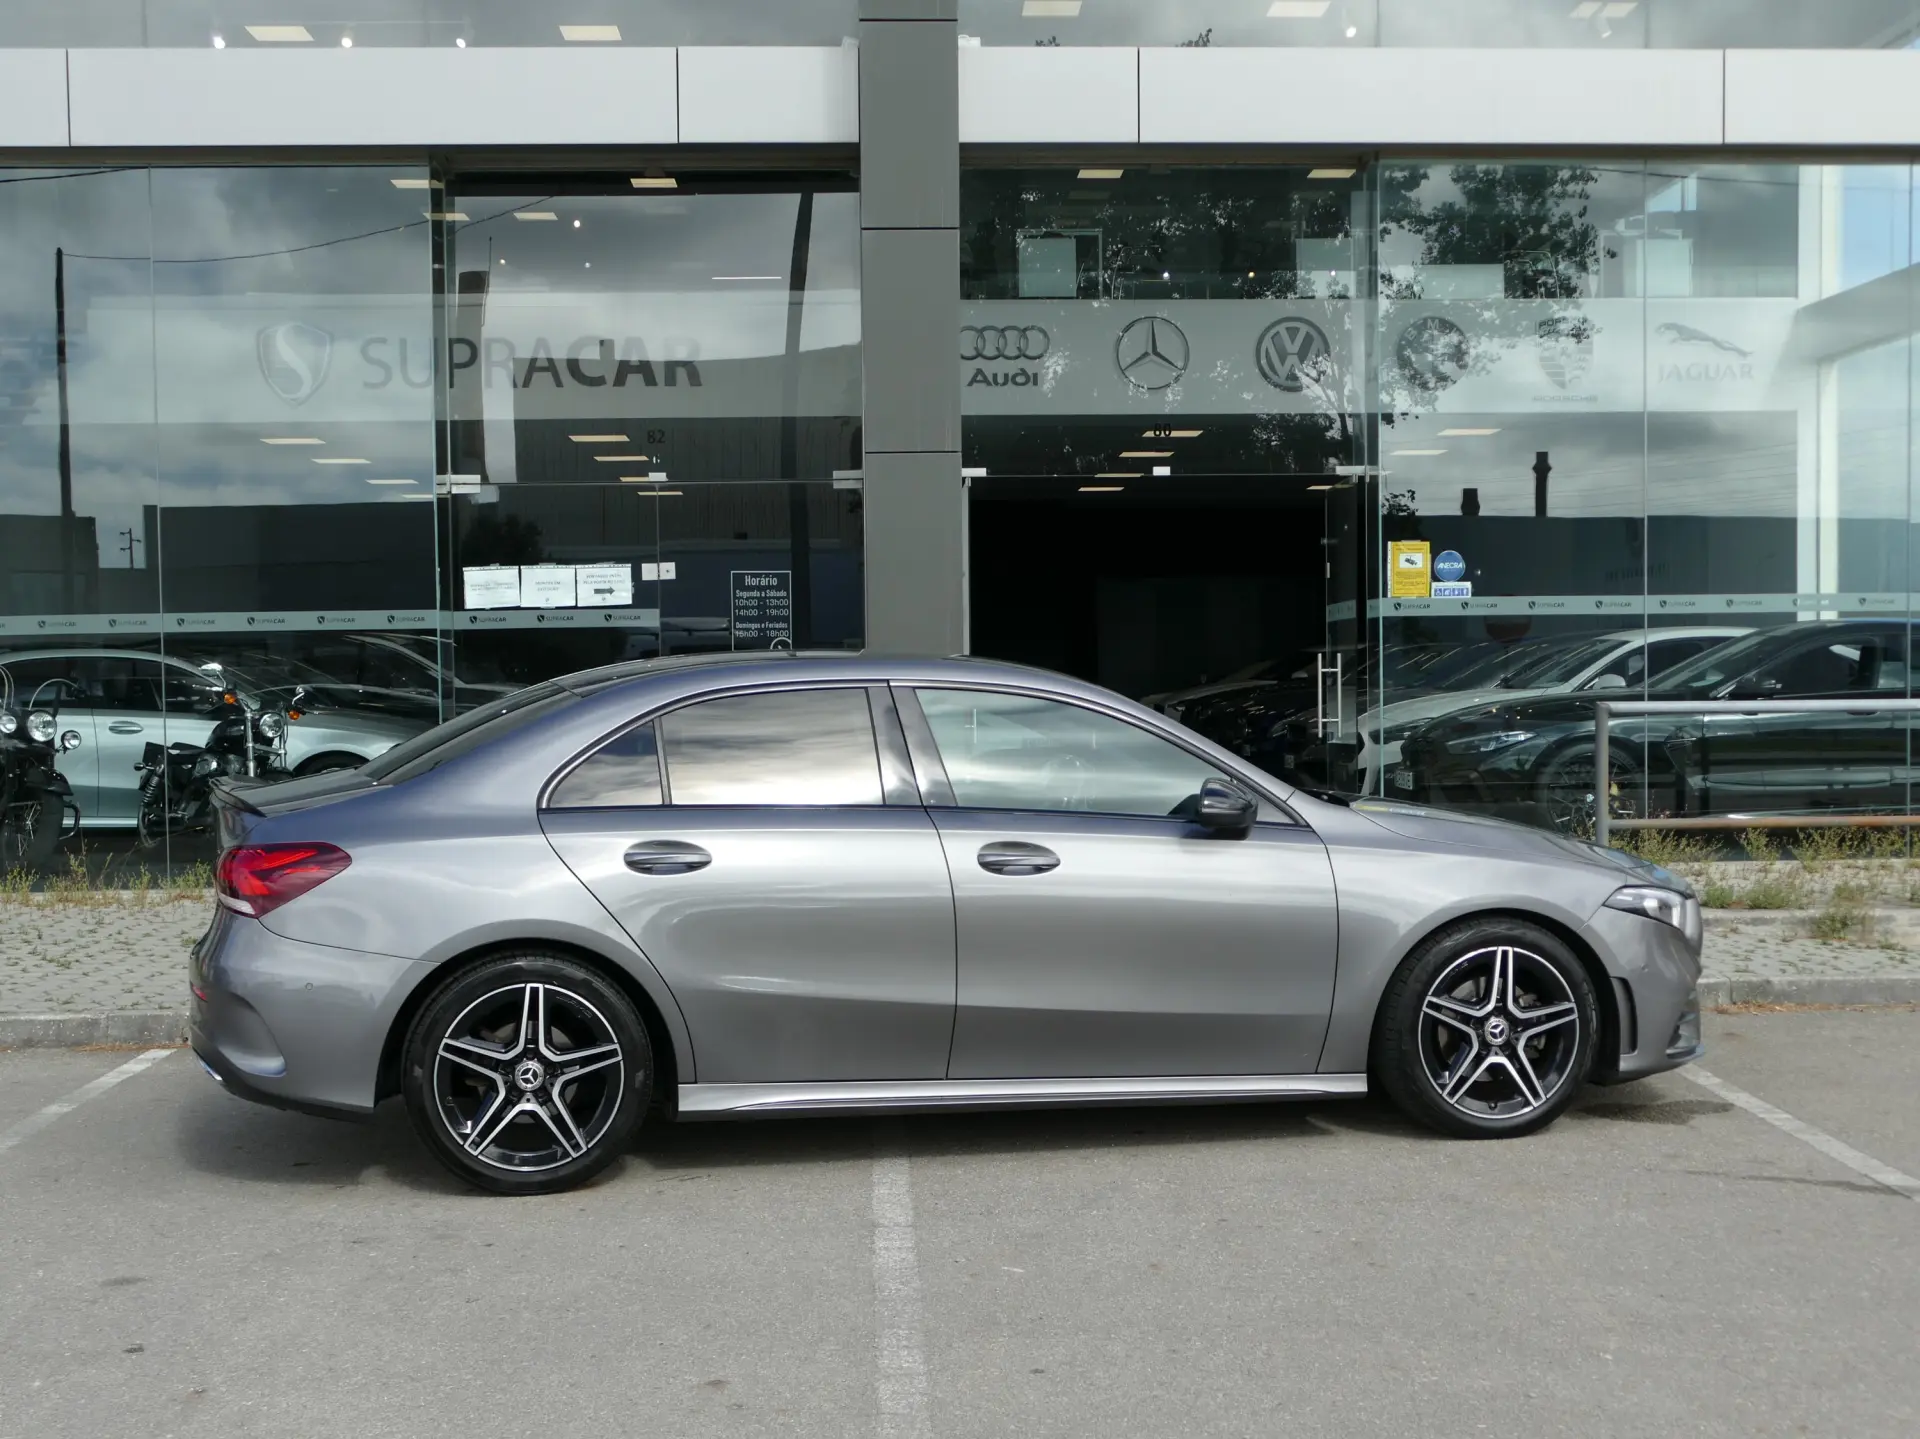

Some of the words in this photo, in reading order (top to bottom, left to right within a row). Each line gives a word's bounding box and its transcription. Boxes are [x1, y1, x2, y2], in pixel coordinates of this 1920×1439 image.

[359, 336, 703, 390] SUPRACAR
[966, 367, 1039, 387] Audi
[1657, 363, 1755, 383] JAGUAR
[646, 429, 666, 444] 82
[744, 574, 778, 586] Horário
[735, 589, 760, 598] Segunda
[766, 589, 787, 597] Sábado
[735, 622, 760, 630] Domingos
